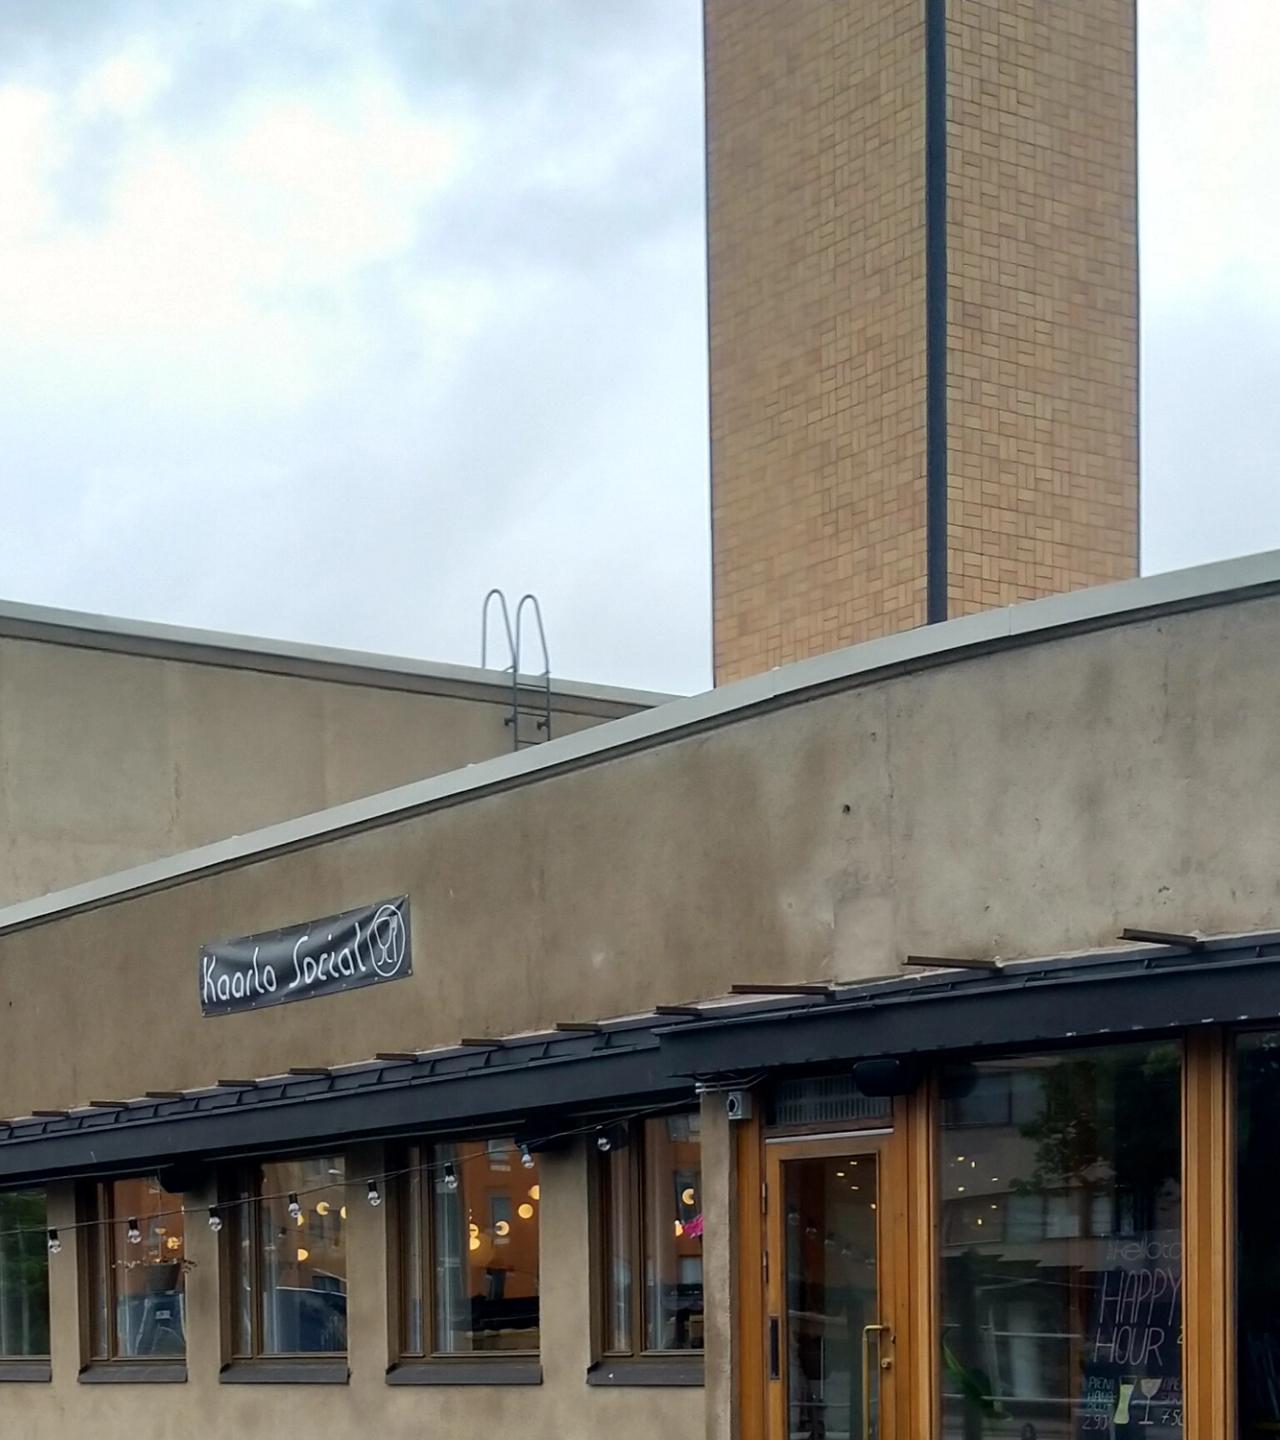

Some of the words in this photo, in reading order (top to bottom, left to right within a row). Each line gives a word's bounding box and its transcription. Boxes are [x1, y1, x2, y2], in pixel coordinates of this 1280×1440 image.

[203, 947, 277, 1003] Kaarlo
[289, 921, 367, 988] Social
[1099, 1267, 1183, 1326] HAPPY
[1093, 1326, 1163, 1366] HOUR
